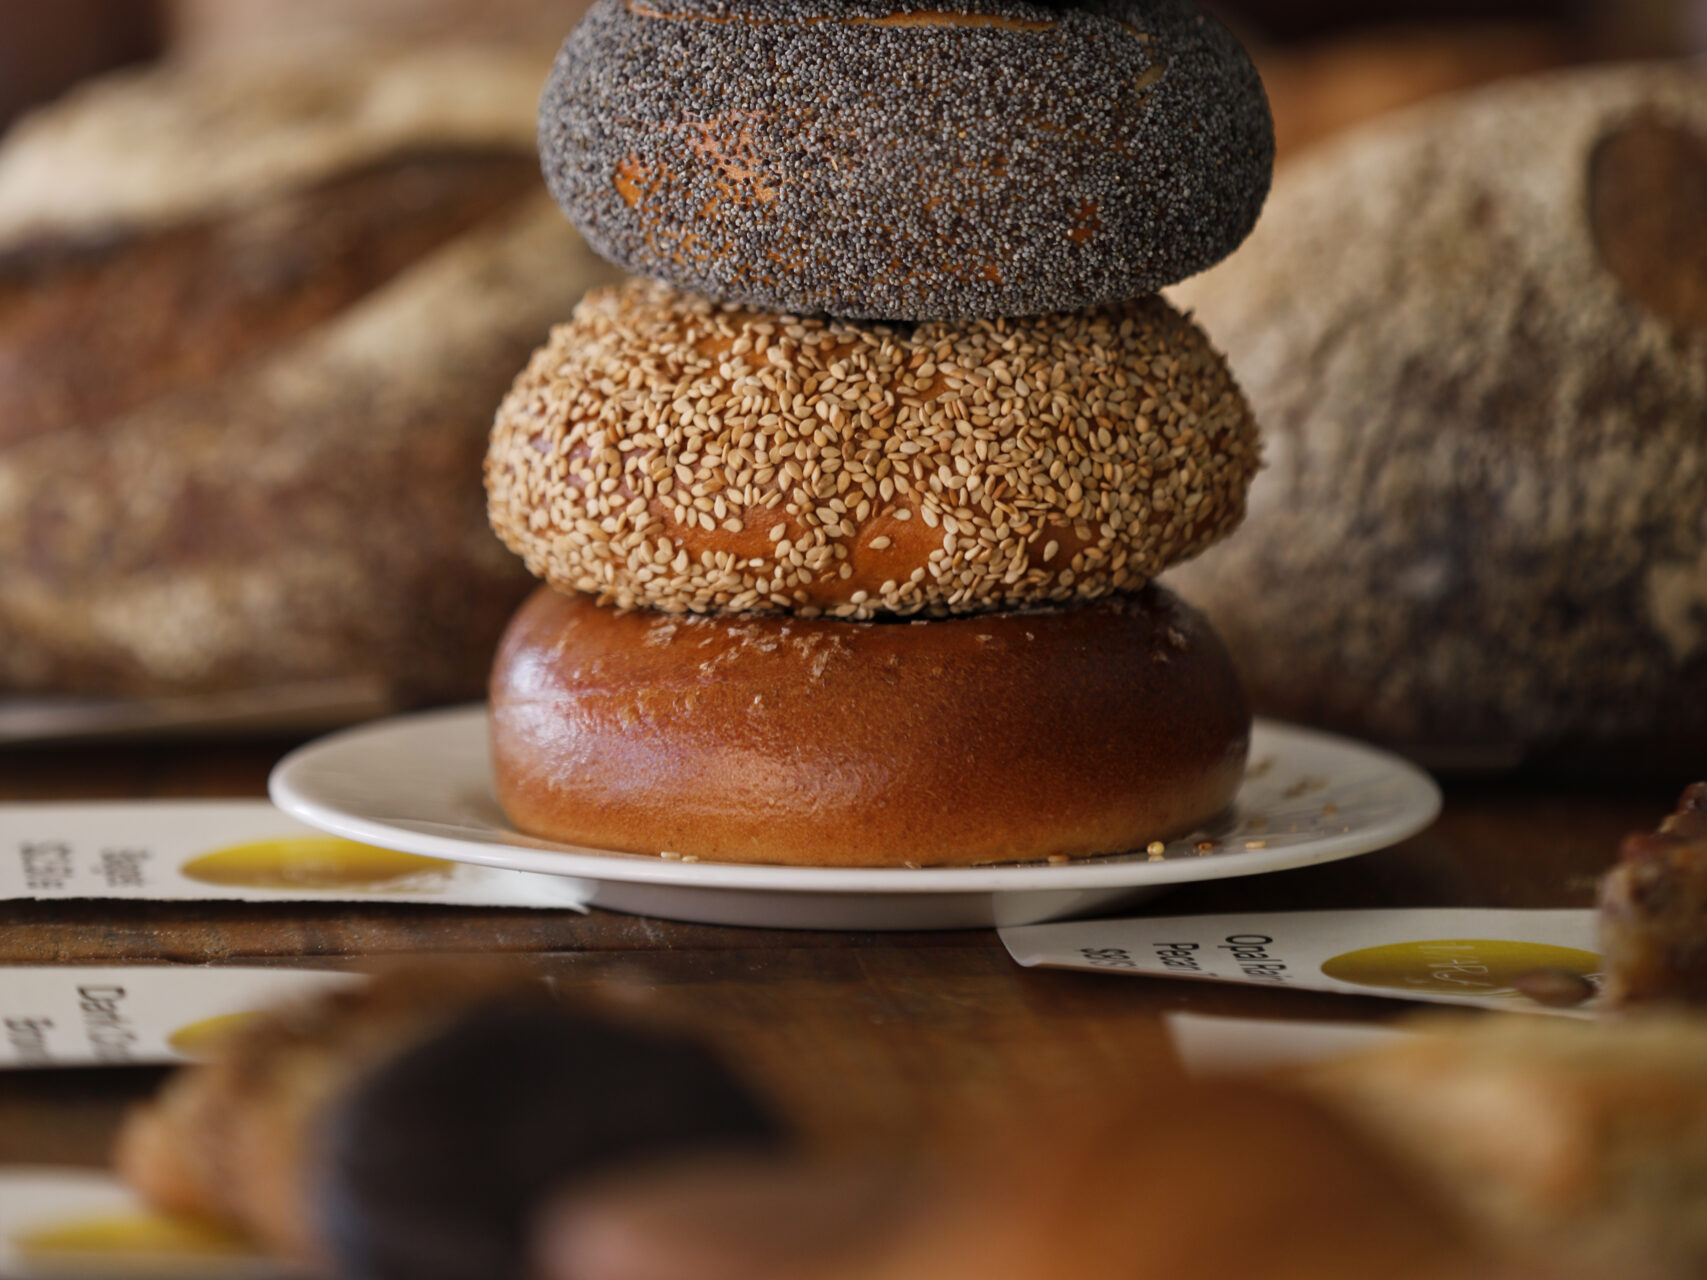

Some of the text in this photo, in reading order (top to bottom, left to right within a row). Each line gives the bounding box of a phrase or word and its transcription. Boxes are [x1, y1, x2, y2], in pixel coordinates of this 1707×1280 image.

[1152, 942, 1203, 971] Pecan
[1217, 934, 1293, 985] Opal Rain
